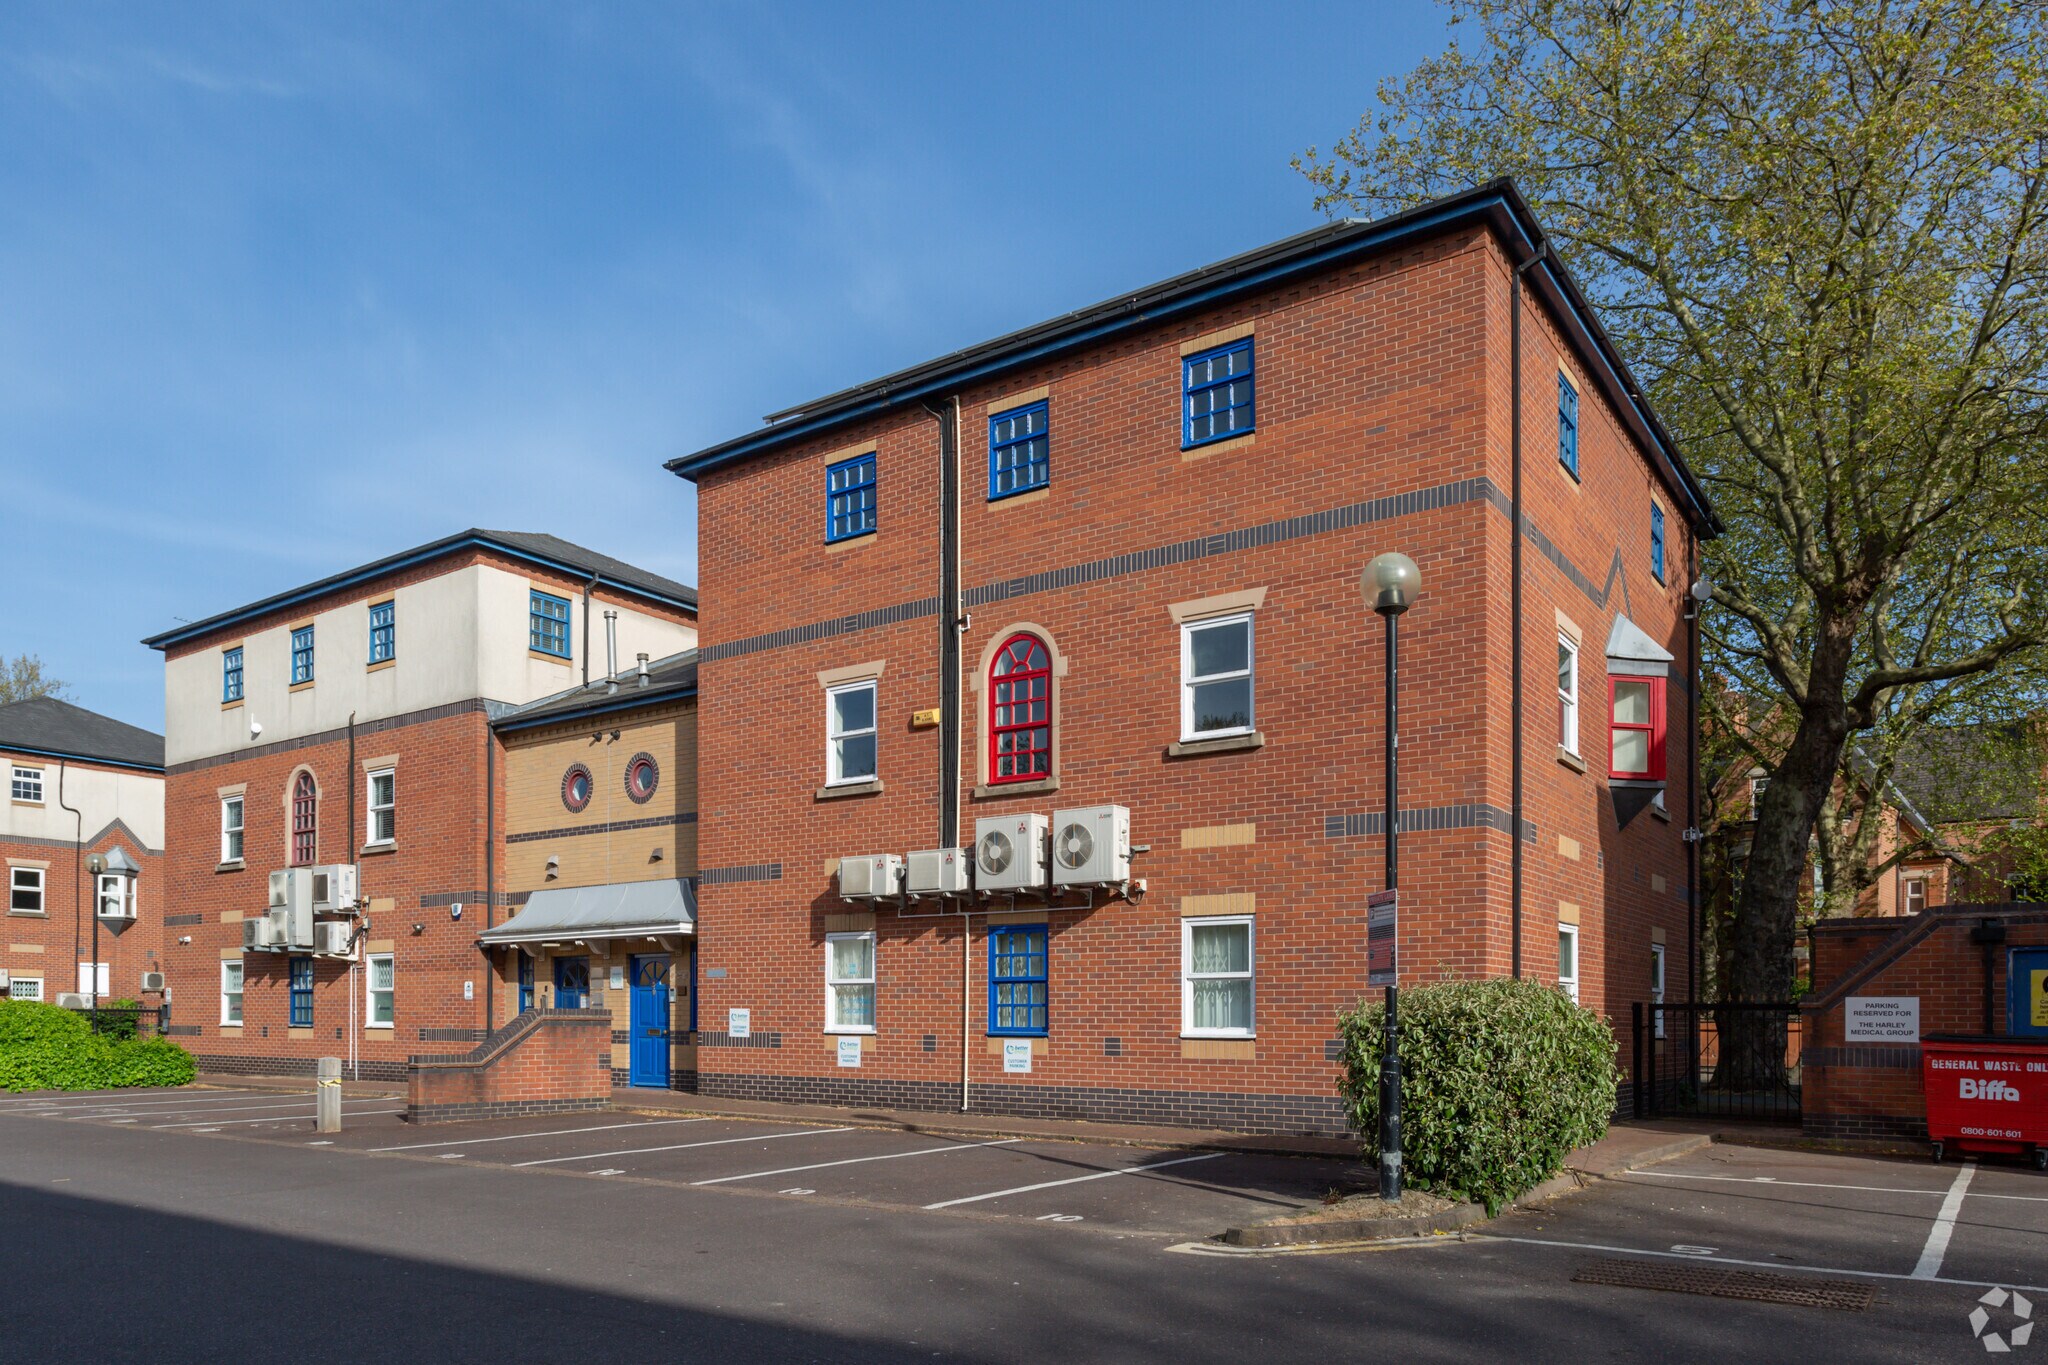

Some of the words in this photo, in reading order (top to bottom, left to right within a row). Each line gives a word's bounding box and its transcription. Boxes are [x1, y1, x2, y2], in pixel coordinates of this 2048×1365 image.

[1931, 1059, 1980, 1070] GENERAL
[1984, 1061, 2021, 1072] WASTE
[2026, 1062, 2048, 1072] ONL
[1959, 1078, 2020, 1102] Biffa
